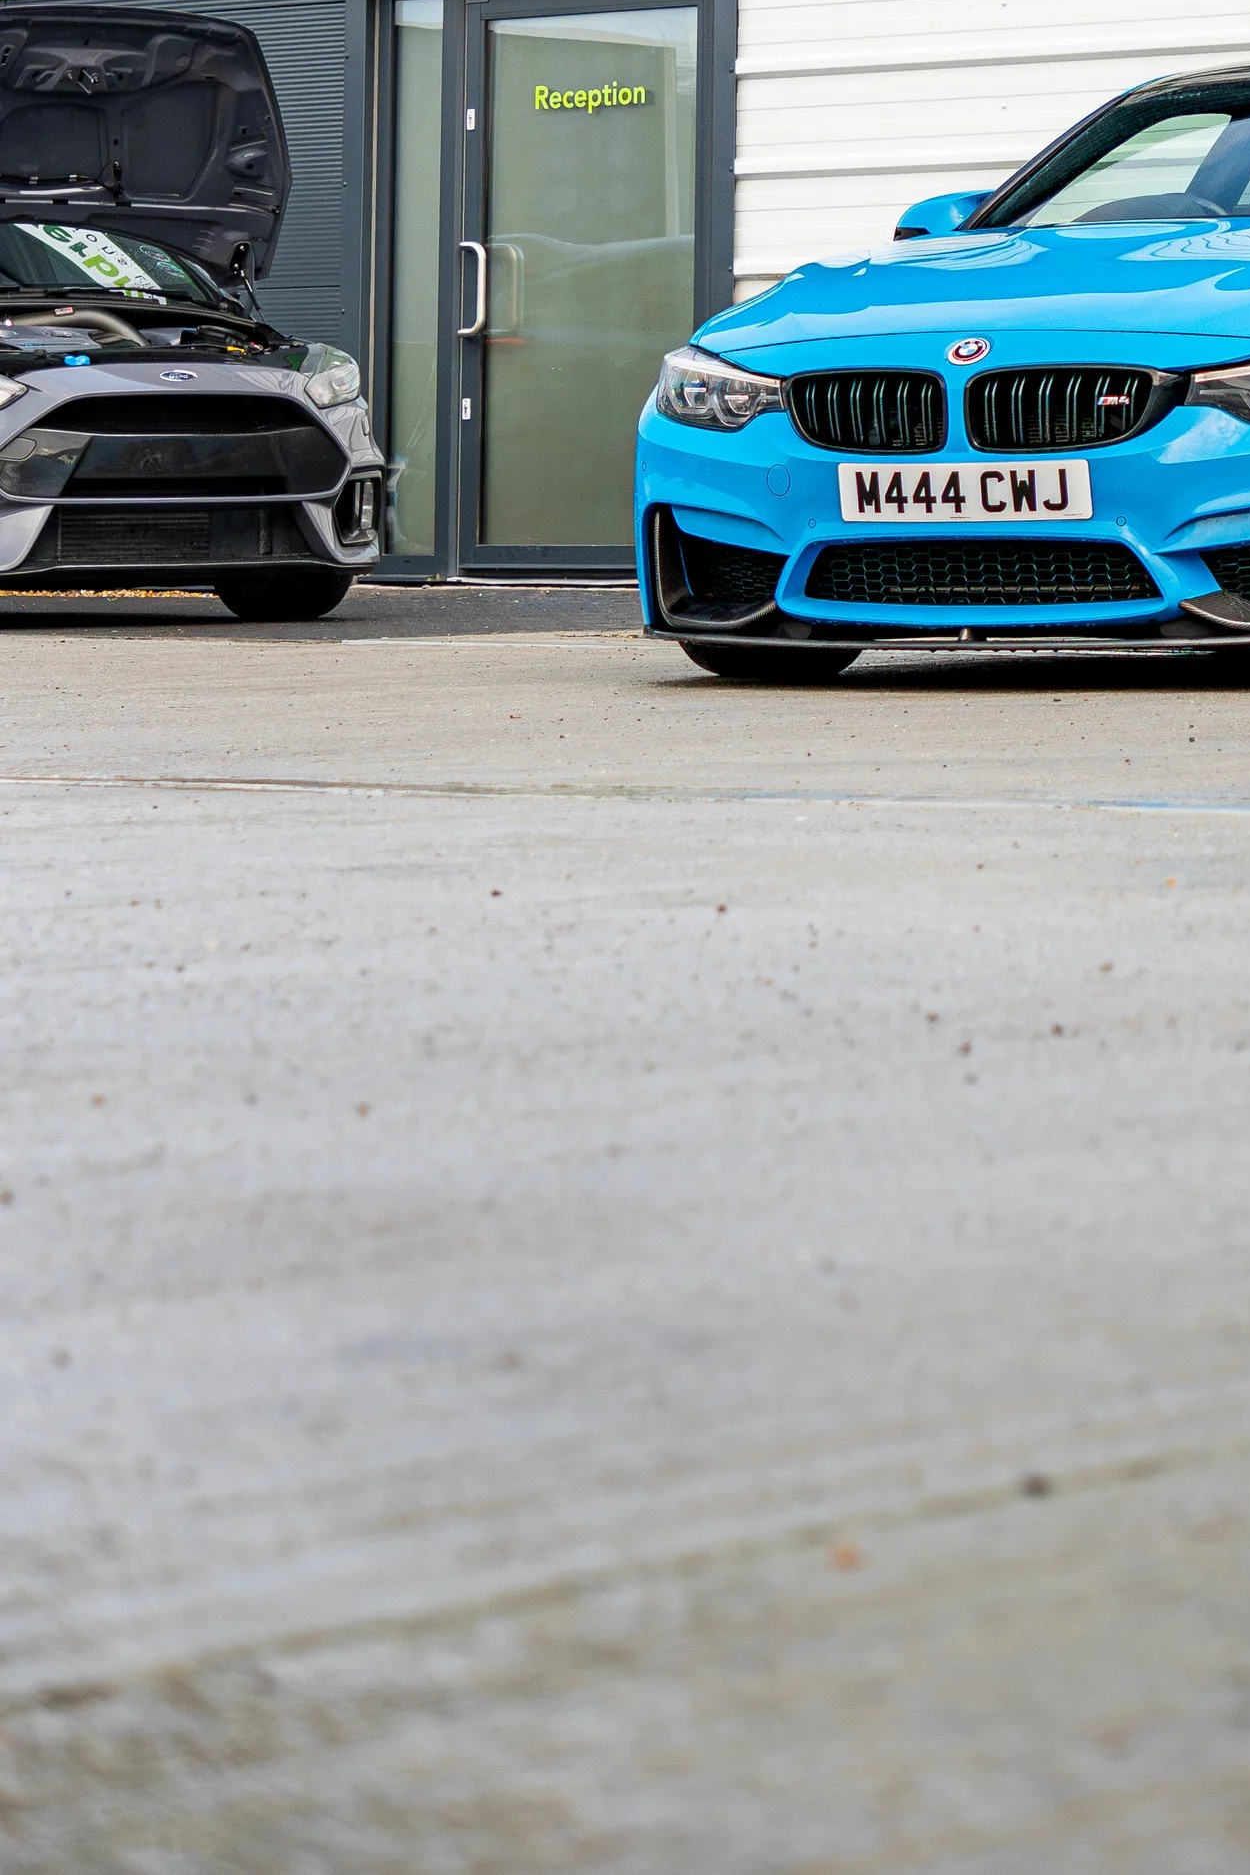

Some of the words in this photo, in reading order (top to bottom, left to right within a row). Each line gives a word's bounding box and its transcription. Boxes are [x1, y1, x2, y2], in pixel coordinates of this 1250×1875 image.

[534, 80, 646, 114] Reception
[855, 470, 967, 514] M444
[979, 468, 1069, 513] CWJ
